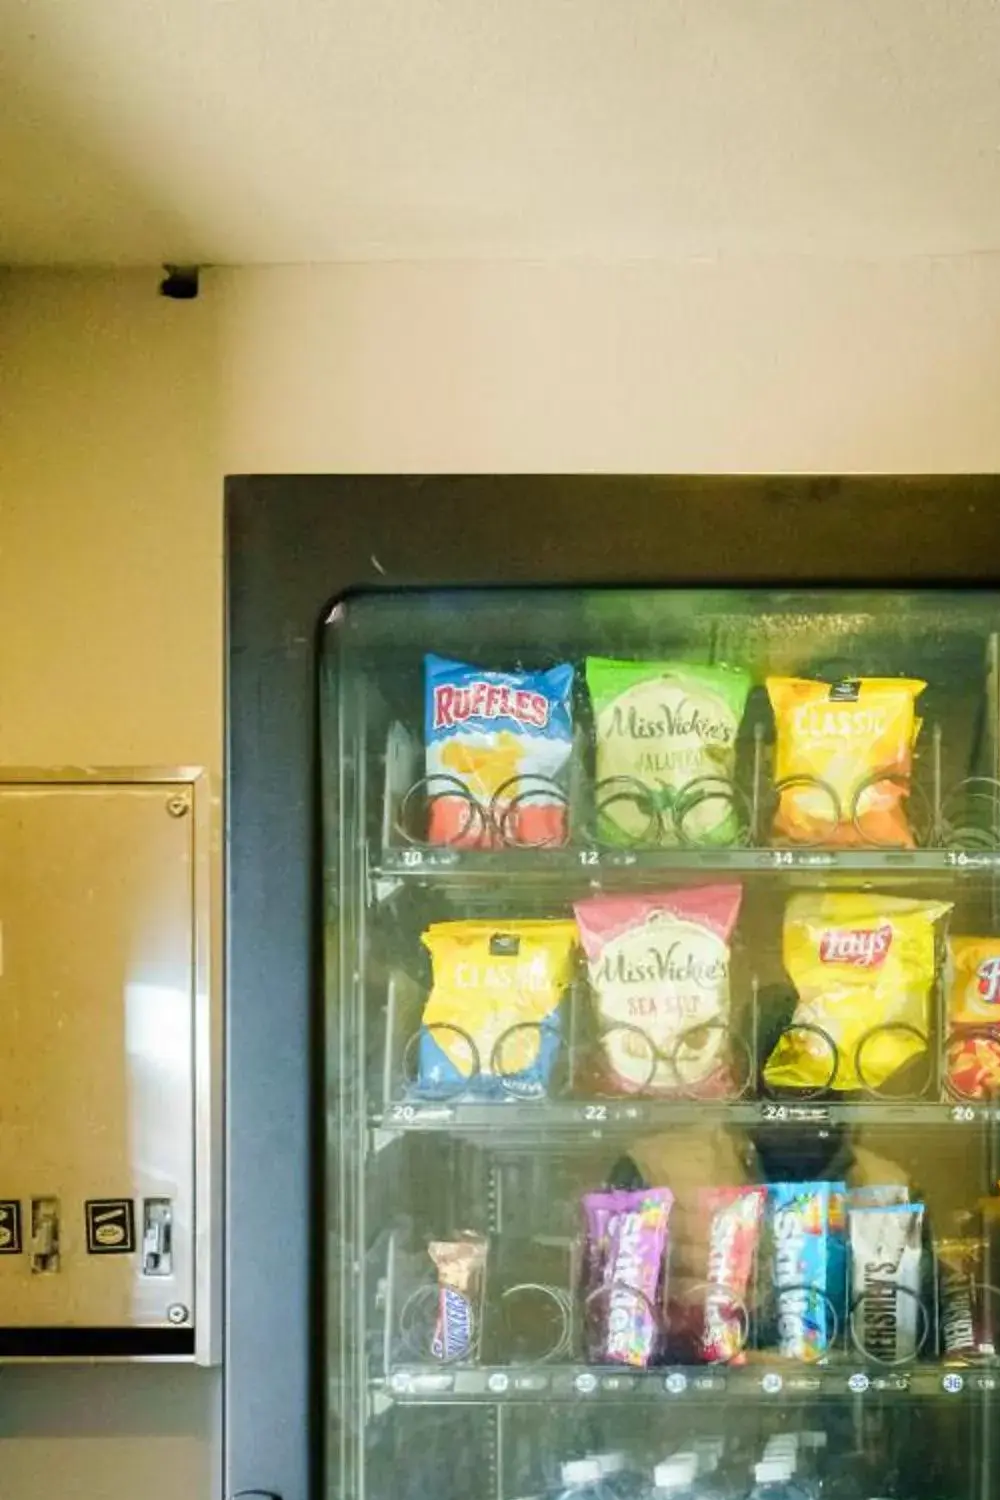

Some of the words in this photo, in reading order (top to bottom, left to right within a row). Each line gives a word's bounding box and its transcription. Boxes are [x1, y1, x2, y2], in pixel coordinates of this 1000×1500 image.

[434, 682, 550, 731] RUFFLES
[792, 700, 887, 738] CLASSIC
[578, 851, 600, 866] 12
[393, 1105, 415, 1121] 20
[585, 1105, 608, 1120] 22
[953, 1106, 975, 1121] 26
[863, 1260, 898, 1361] HERSHEY'S
[944, 1376, 961, 1389] 36
